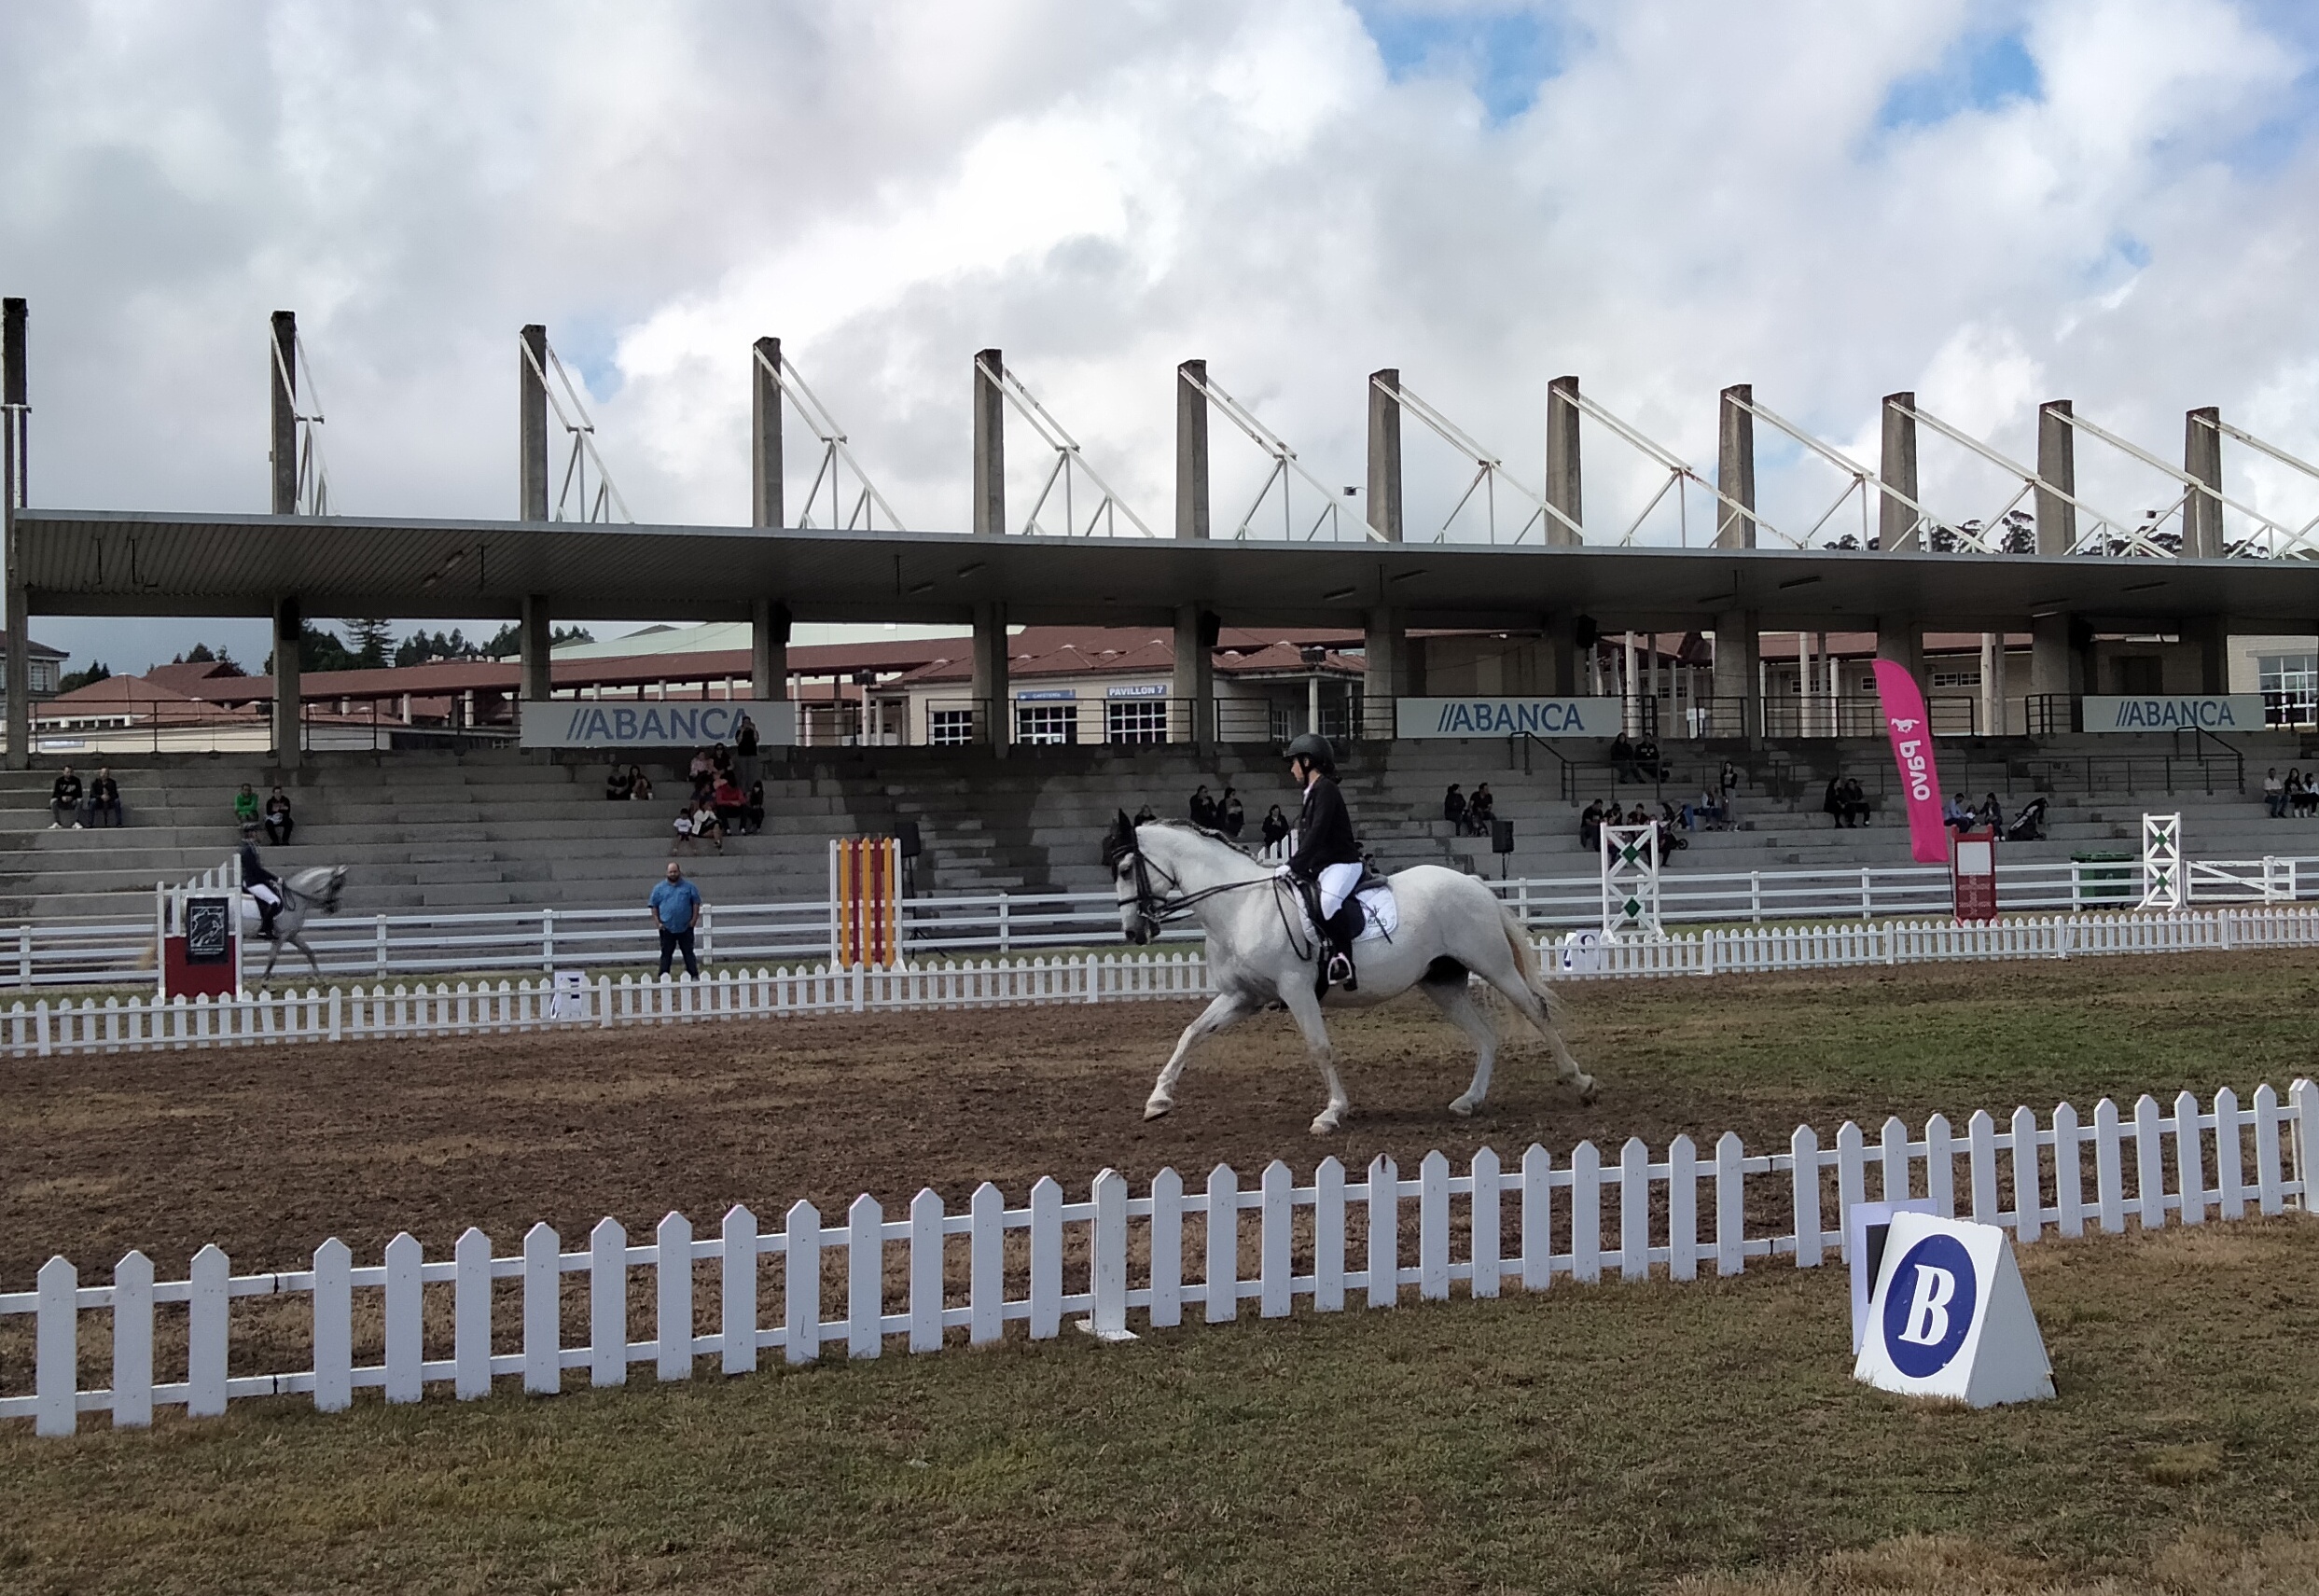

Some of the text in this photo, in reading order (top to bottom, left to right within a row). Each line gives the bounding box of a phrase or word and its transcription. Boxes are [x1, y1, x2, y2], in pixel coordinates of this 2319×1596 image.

[1108, 685, 1164, 696] PAVILLON 7
[1897, 1263, 1956, 1346] B
